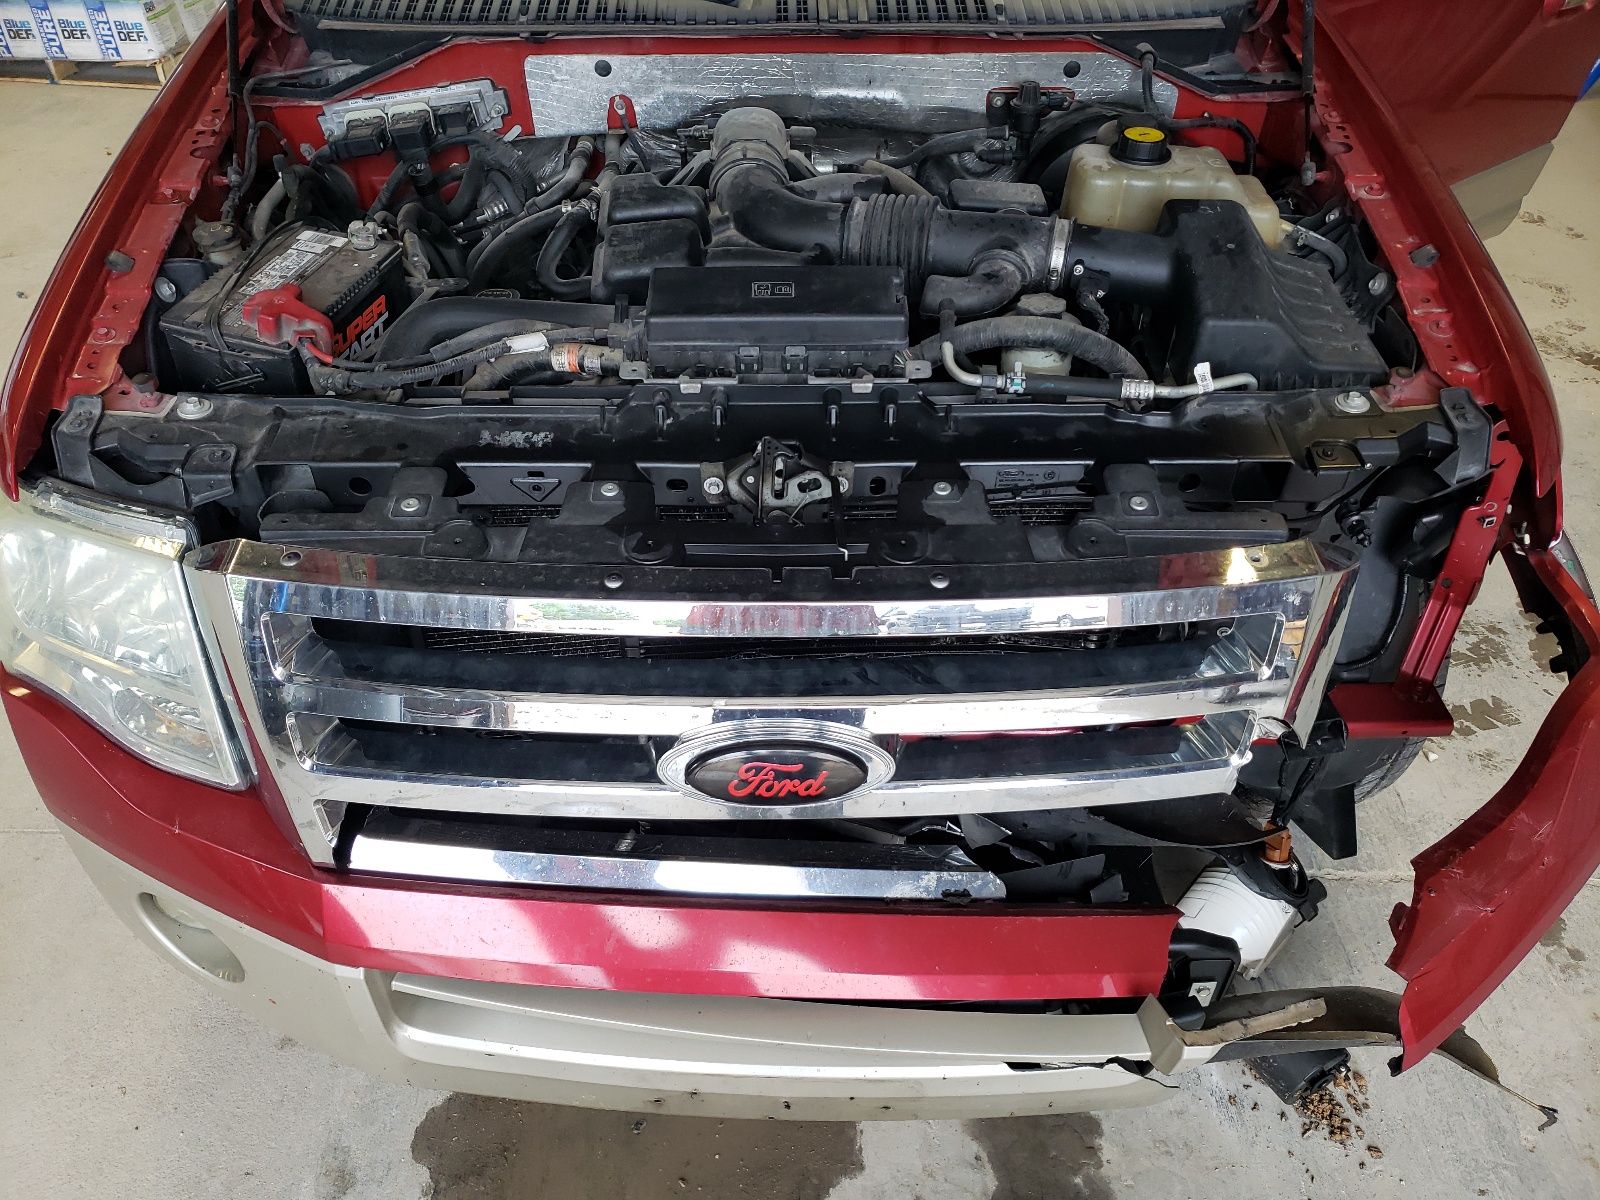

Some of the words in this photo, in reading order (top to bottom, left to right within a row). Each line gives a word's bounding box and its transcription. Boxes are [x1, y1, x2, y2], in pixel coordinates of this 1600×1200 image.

[3, 19, 31, 28] Blue
[58, 18, 86, 28] Blue
[114, 20, 143, 30] Blue
[7, 29, 33, 39] DEF
[38, 9, 67, 58] PURE
[61, 29, 87, 39] DEF
[94, 11, 121, 59] PURE
[117, 31, 144, 41] DEF
[339, 311, 388, 361] ART
[727, 761, 829, 797] Ford
